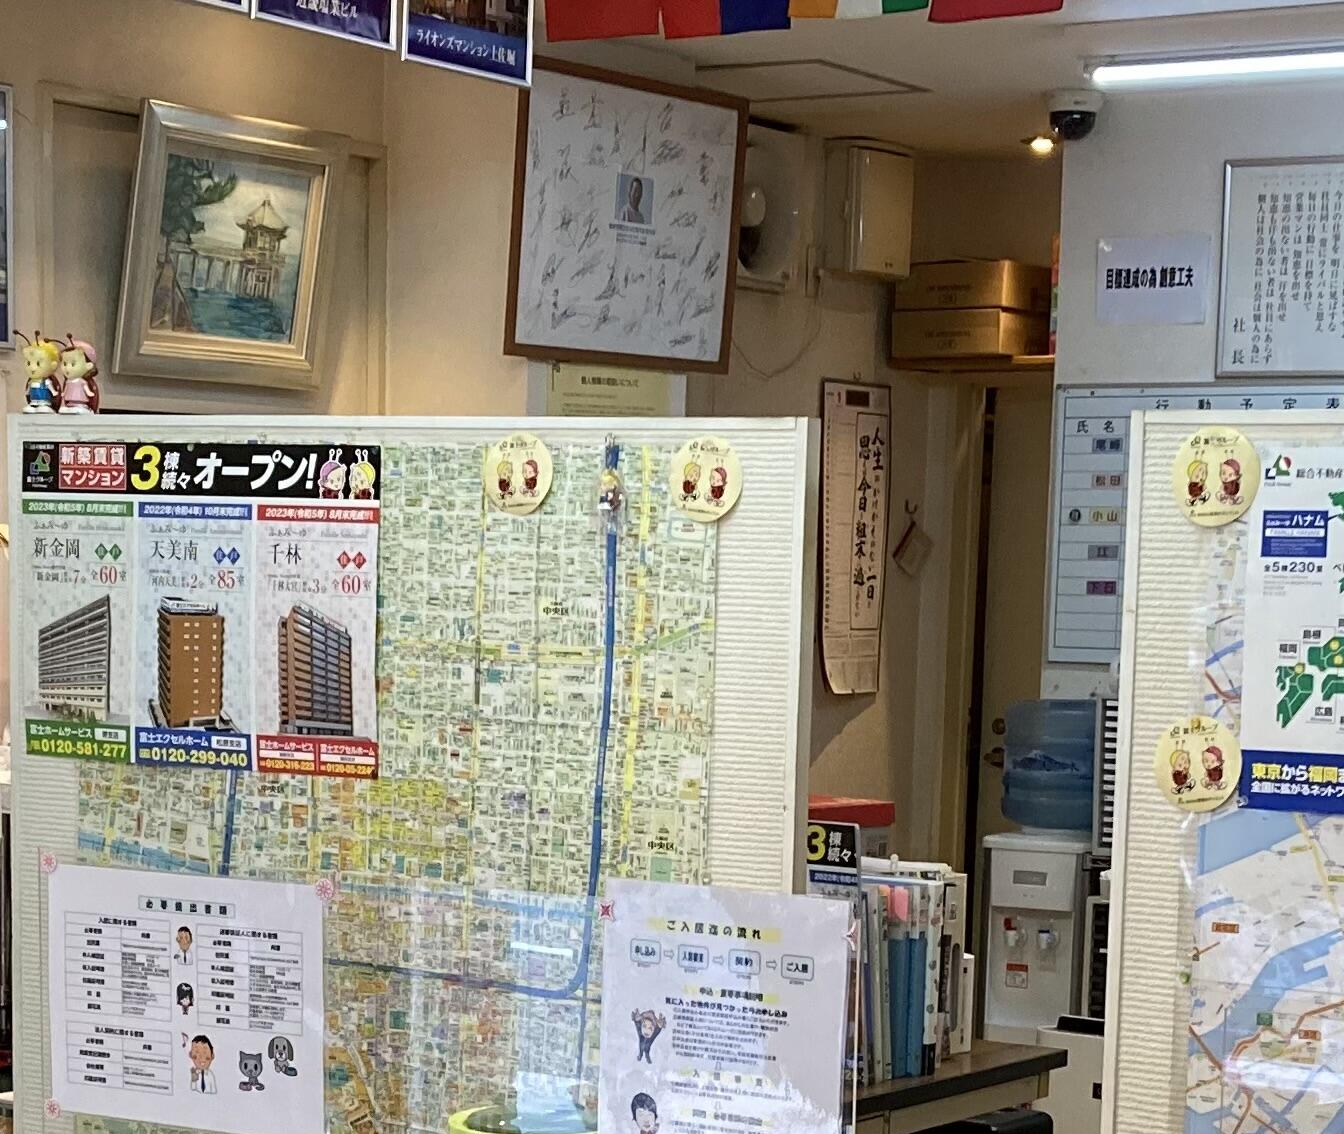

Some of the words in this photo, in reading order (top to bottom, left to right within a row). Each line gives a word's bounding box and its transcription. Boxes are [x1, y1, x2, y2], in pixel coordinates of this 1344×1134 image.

[1159, 265, 1194, 288] 創意工夫
[1076, 420, 1115, 433] 氏名
[60, 446, 125, 466] 新築賃貸
[164, 451, 180, 470] 棟
[61, 468, 125, 487] マンション
[130, 445, 161, 491] 3
[193, 448, 318, 491] オープン!
[161, 470, 192, 491] 続々
[1092, 510, 1118, 523] 小山
[33, 535, 81, 559] 新金岡
[149, 538, 198, 560] 天美南
[268, 543, 302, 565] 千林
[30, 724, 93, 739] 富士ホームサービス
[139, 731, 210, 747] 富士エクセルホーム
[41, 739, 127, 759] 0120-581-277
[150, 748, 248, 767] 0120-299-040
[807, 824, 826, 861] 3
